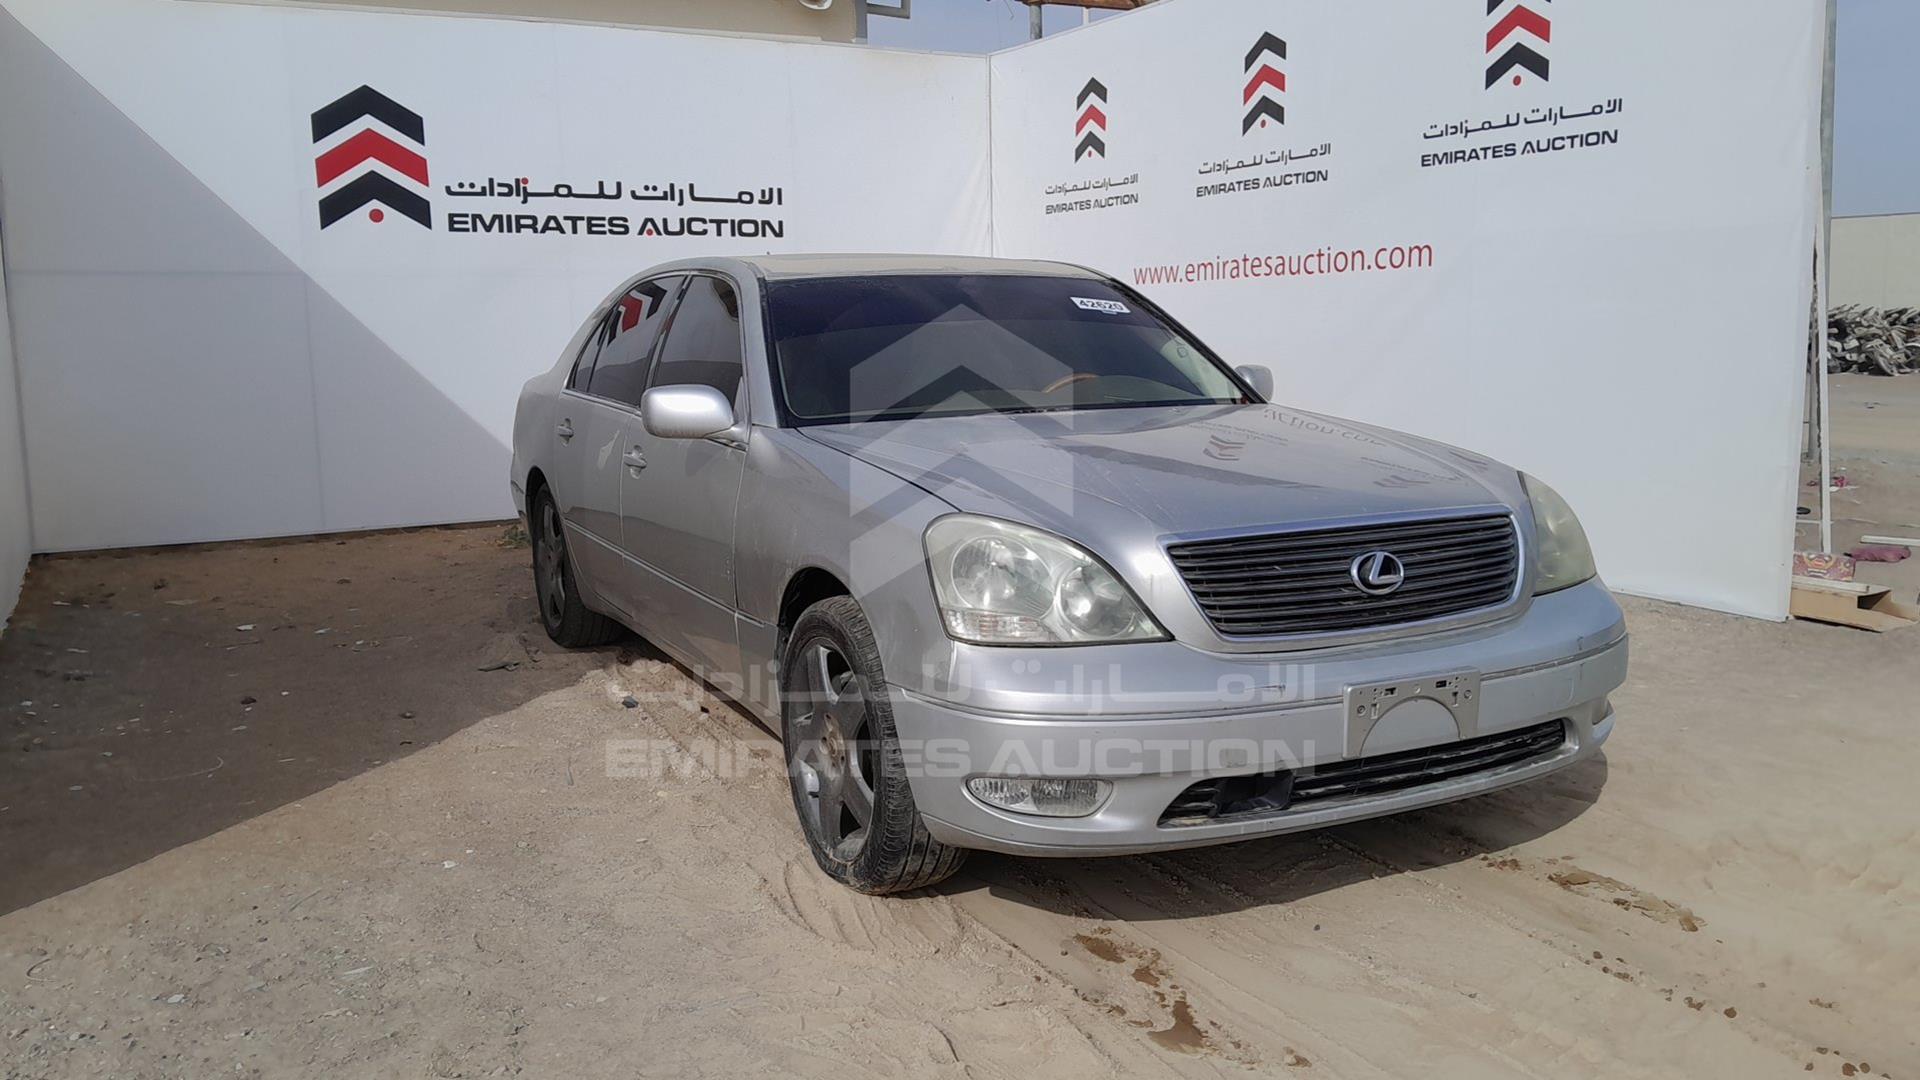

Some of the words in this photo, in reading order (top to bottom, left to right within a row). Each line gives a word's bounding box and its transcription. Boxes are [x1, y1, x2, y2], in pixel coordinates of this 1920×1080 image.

[1422, 112, 1520, 140] للمزادات
[1421, 142, 1517, 167] EMIRATES
[1521, 129, 1618, 155] AUCTION
[444, 177, 622, 204] للمزادات
[1196, 178, 1260, 197] EMIRATES
[1263, 169, 1328, 188] AUCTION
[1045, 200, 1092, 215] EMIRATES
[1092, 193, 1139, 210] AUCTION
[447, 213, 630, 236] EMIRATES
[637, 216, 784, 238] AUCTION
[1133, 243, 1433, 285] www.emiratesauction.com
